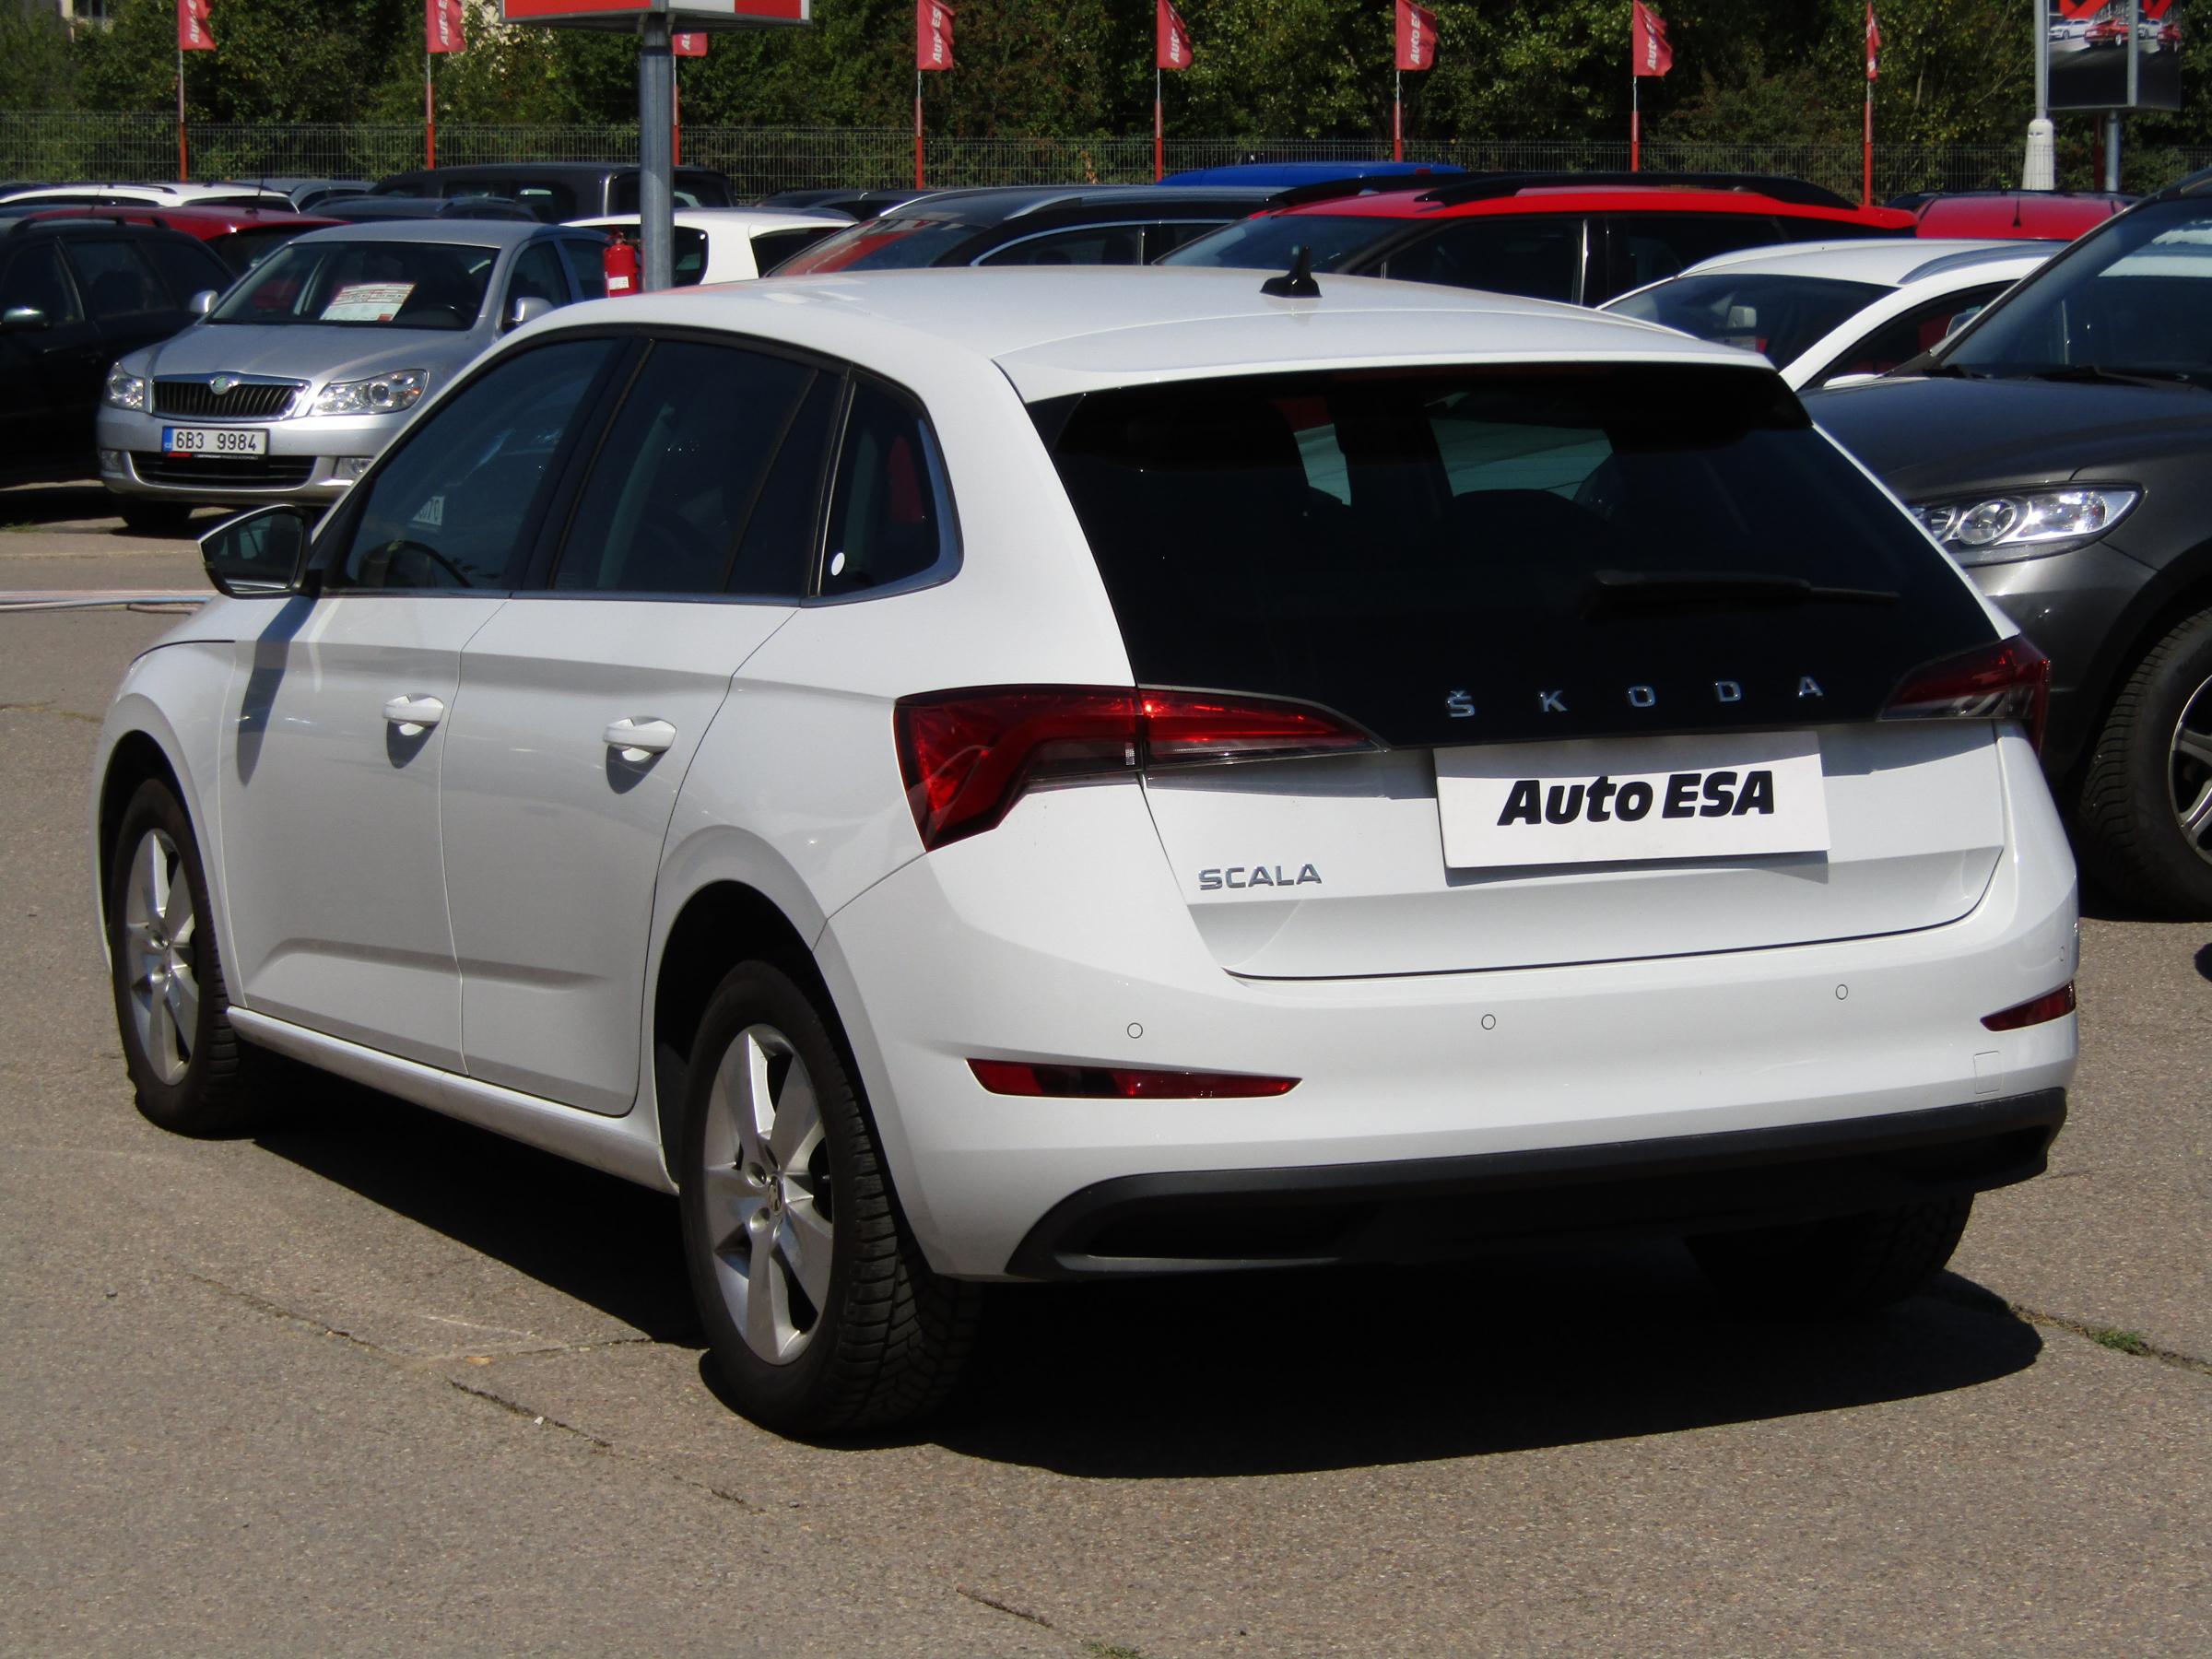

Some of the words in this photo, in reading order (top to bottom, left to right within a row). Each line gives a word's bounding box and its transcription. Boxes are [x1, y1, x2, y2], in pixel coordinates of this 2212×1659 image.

[189, 11, 200, 43] Aut
[1410, 29, 1421, 65] Auto
[176, 431, 205, 449] 6B3
[217, 433, 257, 451] 9984
[1447, 676, 1824, 717] ŠKODA
[1497, 775, 1653, 826] Auto
[1662, 770, 1774, 818] ESA
[1198, 864, 1323, 890] SCALA
